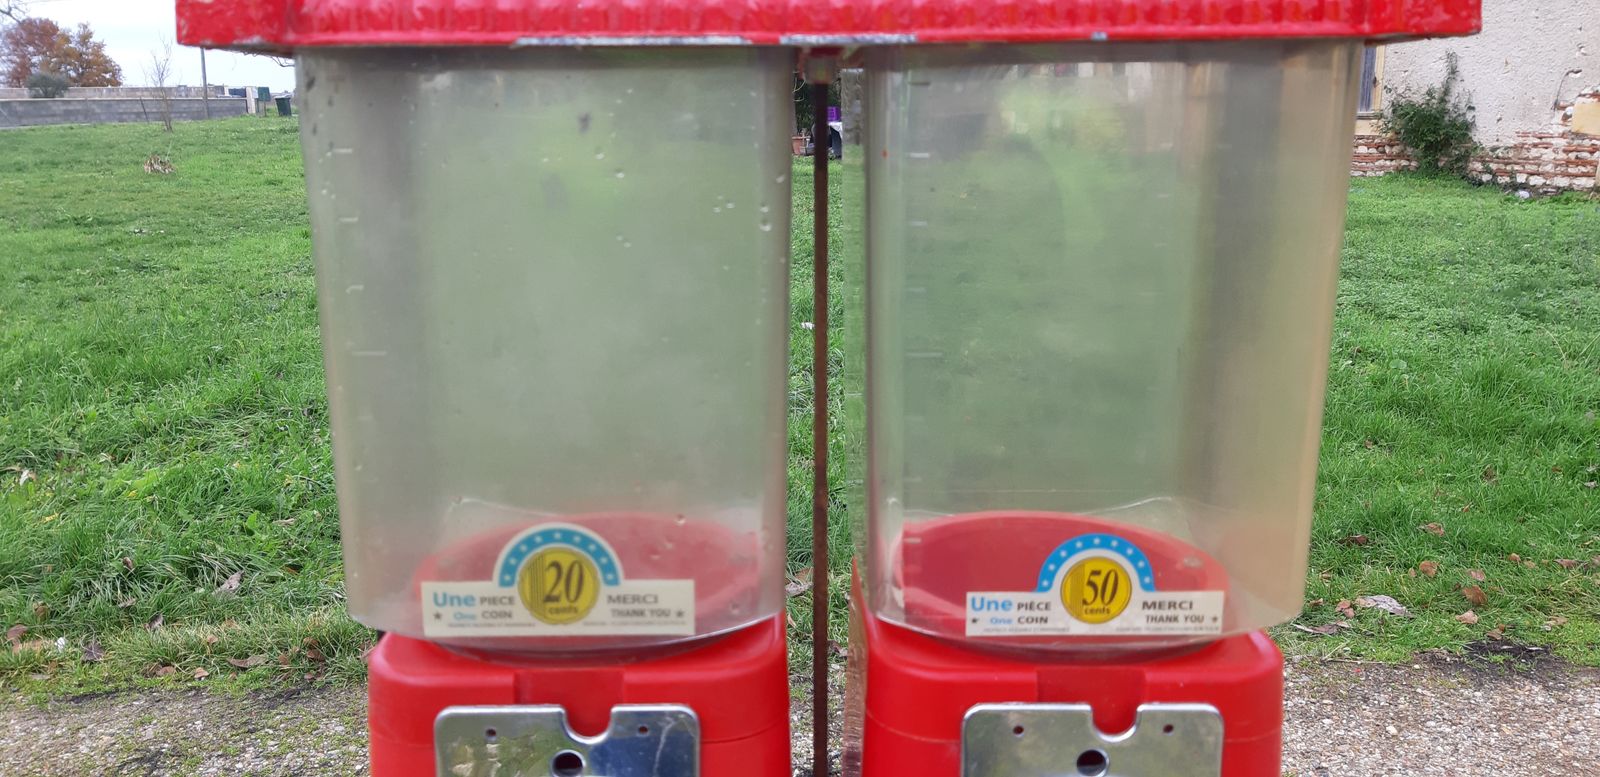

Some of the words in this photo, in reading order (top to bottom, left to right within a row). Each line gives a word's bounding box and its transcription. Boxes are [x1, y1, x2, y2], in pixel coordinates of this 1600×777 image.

[544, 560, 585, 603] 20
[1082, 569, 1119, 607] 50
[433, 592, 476, 608] Une
[606, 593, 659, 604] MERCI
[971, 596, 1013, 612] Une
[1017, 600, 1051, 611] PIÈCE
[548, 605, 579, 616] cents
[1084, 606, 1111, 616] cents
[1142, 600, 1193, 611] MERCI
[453, 611, 477, 621] One
[481, 610, 513, 620] COIN
[611, 607, 646, 618] THANK
[649, 607, 671, 618] YOU
[990, 616, 1013, 625] One
[1017, 616, 1048, 625] COIN
[1145, 614, 1179, 624] THANK
[1183, 614, 1204, 624] YOU
